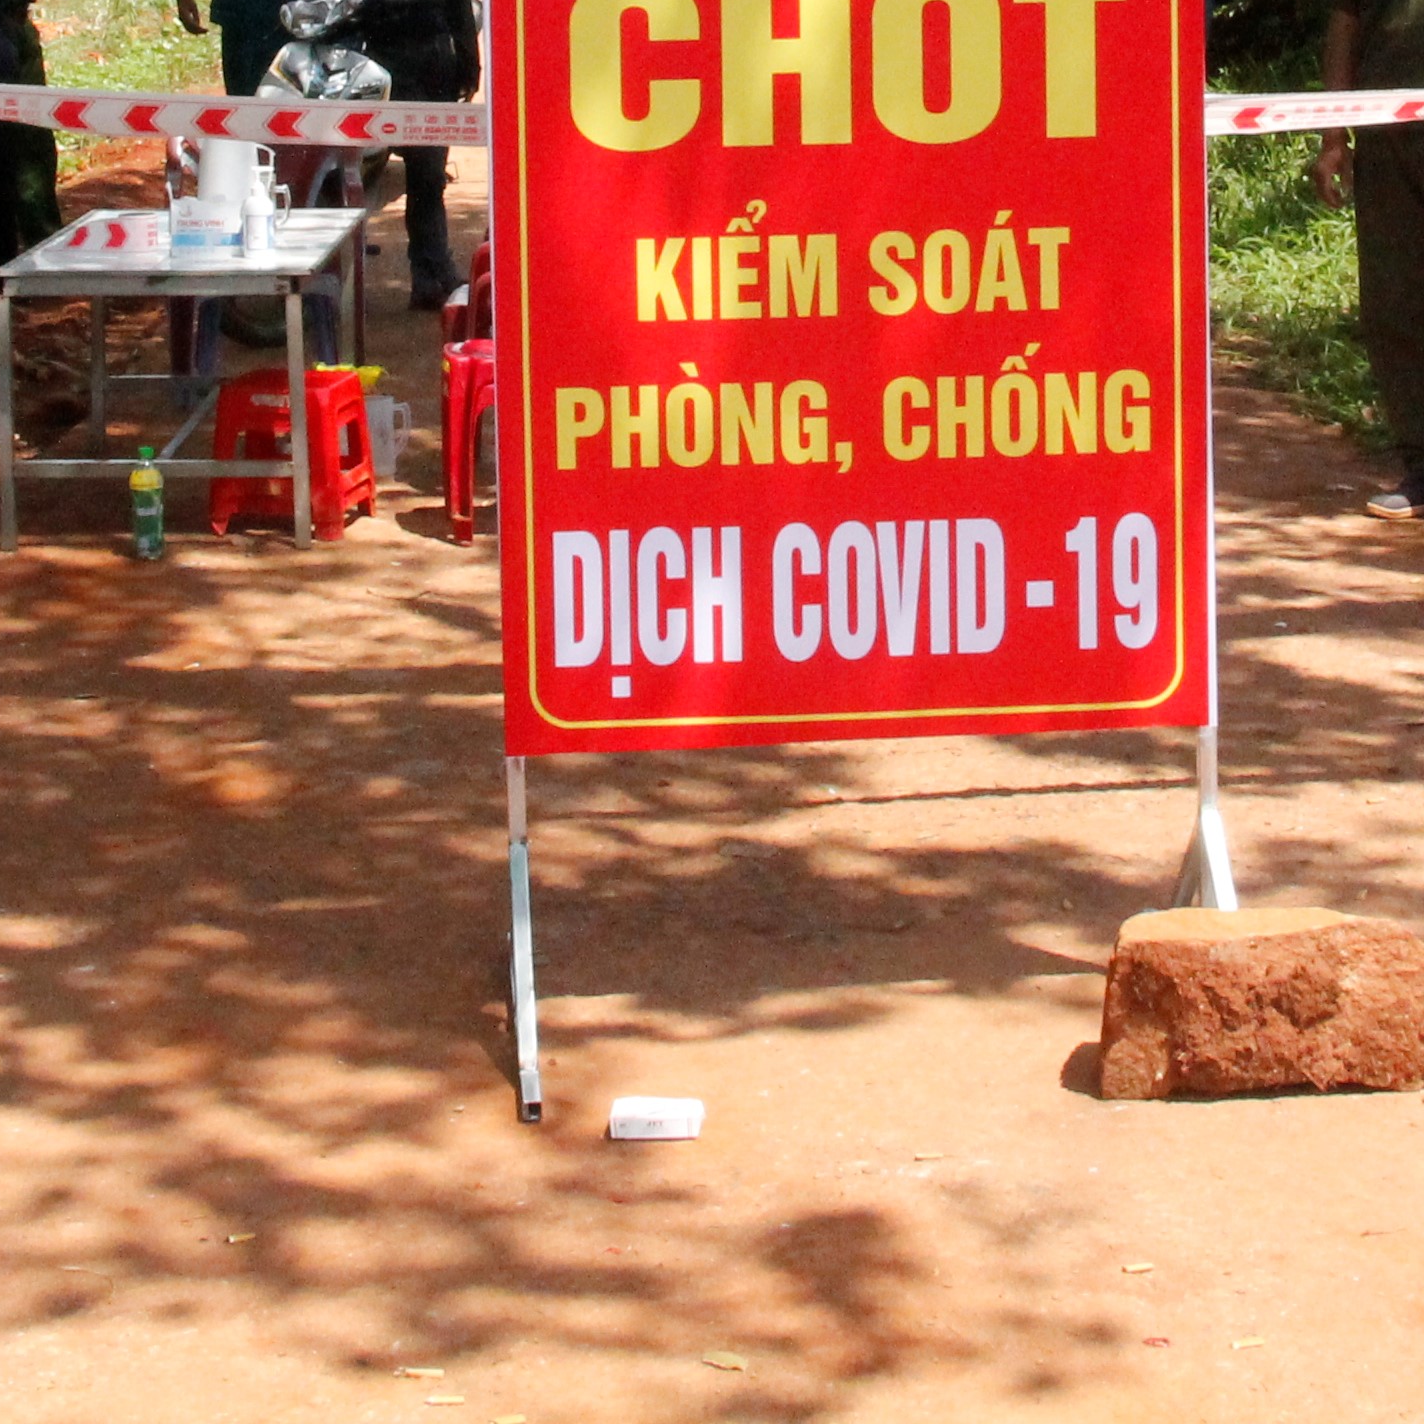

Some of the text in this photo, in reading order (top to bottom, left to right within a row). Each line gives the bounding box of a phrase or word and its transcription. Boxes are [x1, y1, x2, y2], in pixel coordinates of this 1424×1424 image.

[634, 198, 1071, 323] KIỂM SOÁT
[554, 341, 1153, 475] PHÒNG, CHỐNG
[551, 511, 1160, 700] DỊCH COVID -19
